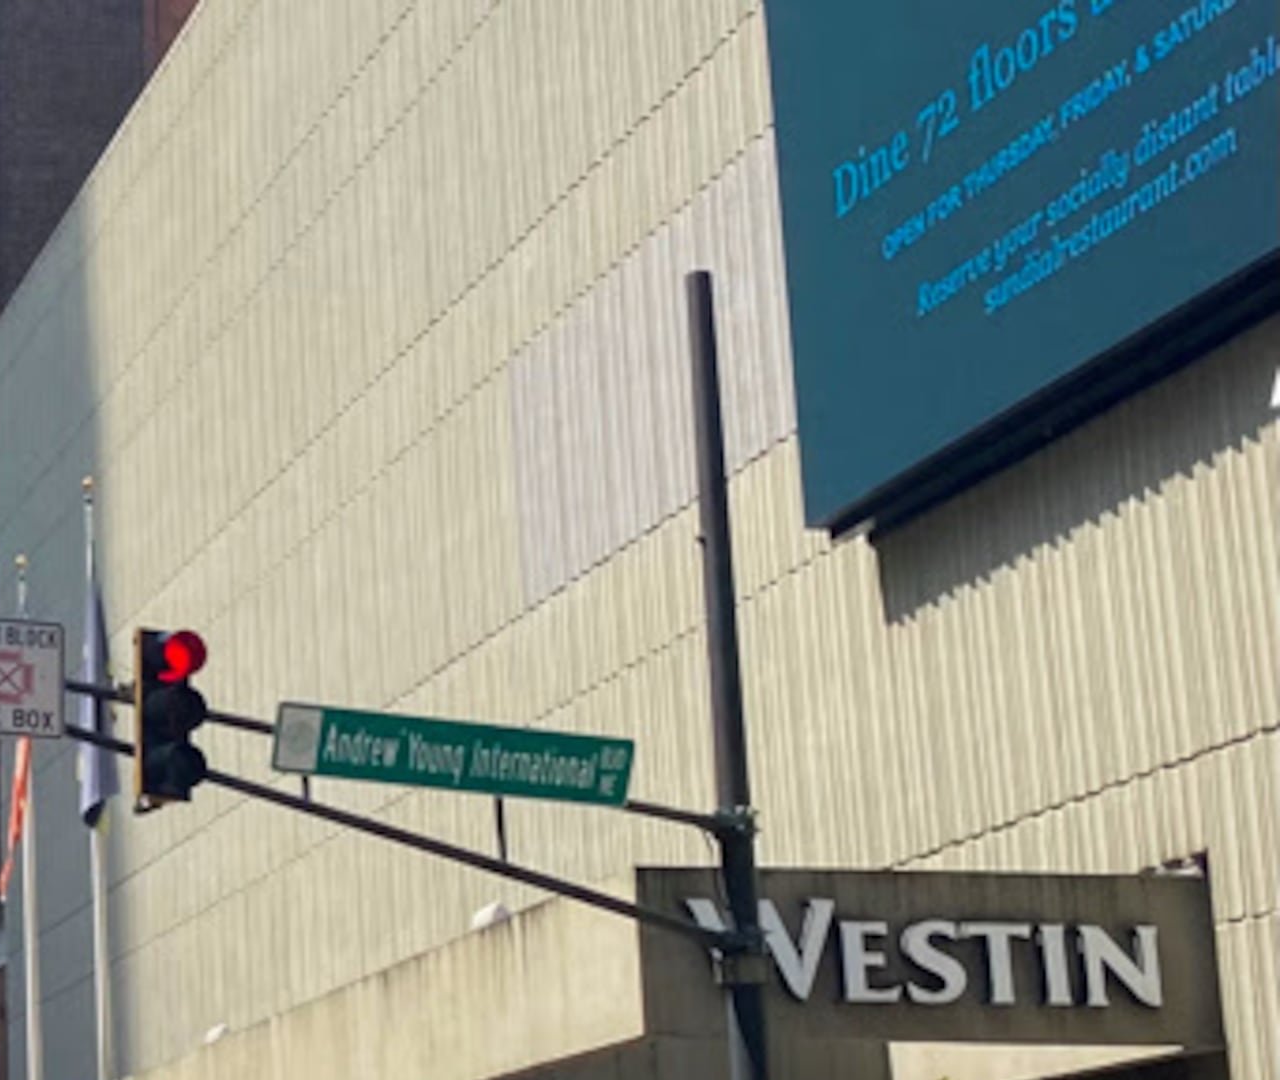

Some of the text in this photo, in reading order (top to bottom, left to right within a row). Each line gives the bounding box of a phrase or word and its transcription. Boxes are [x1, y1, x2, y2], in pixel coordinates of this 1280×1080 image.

[833, 0, 1078, 218] Dine 72 floors
[882, 211, 926, 260] OPEN
[927, 184, 963, 226] FOR
[1135, 45, 1150, 73] &
[918, 247, 991, 317] Reserve
[993, 211, 1042, 272] your
[1046, 149, 1131, 227] socially
[1133, 82, 1218, 167] distant
[984, 127, 1238, 316] sundialrestaurant.com
[7, 626, 57, 650] BLOCK
[12, 707, 54, 732] BOX
[323, 722, 600, 792] Andrew Young International
[685, 896, 1165, 1010] WESTIN
